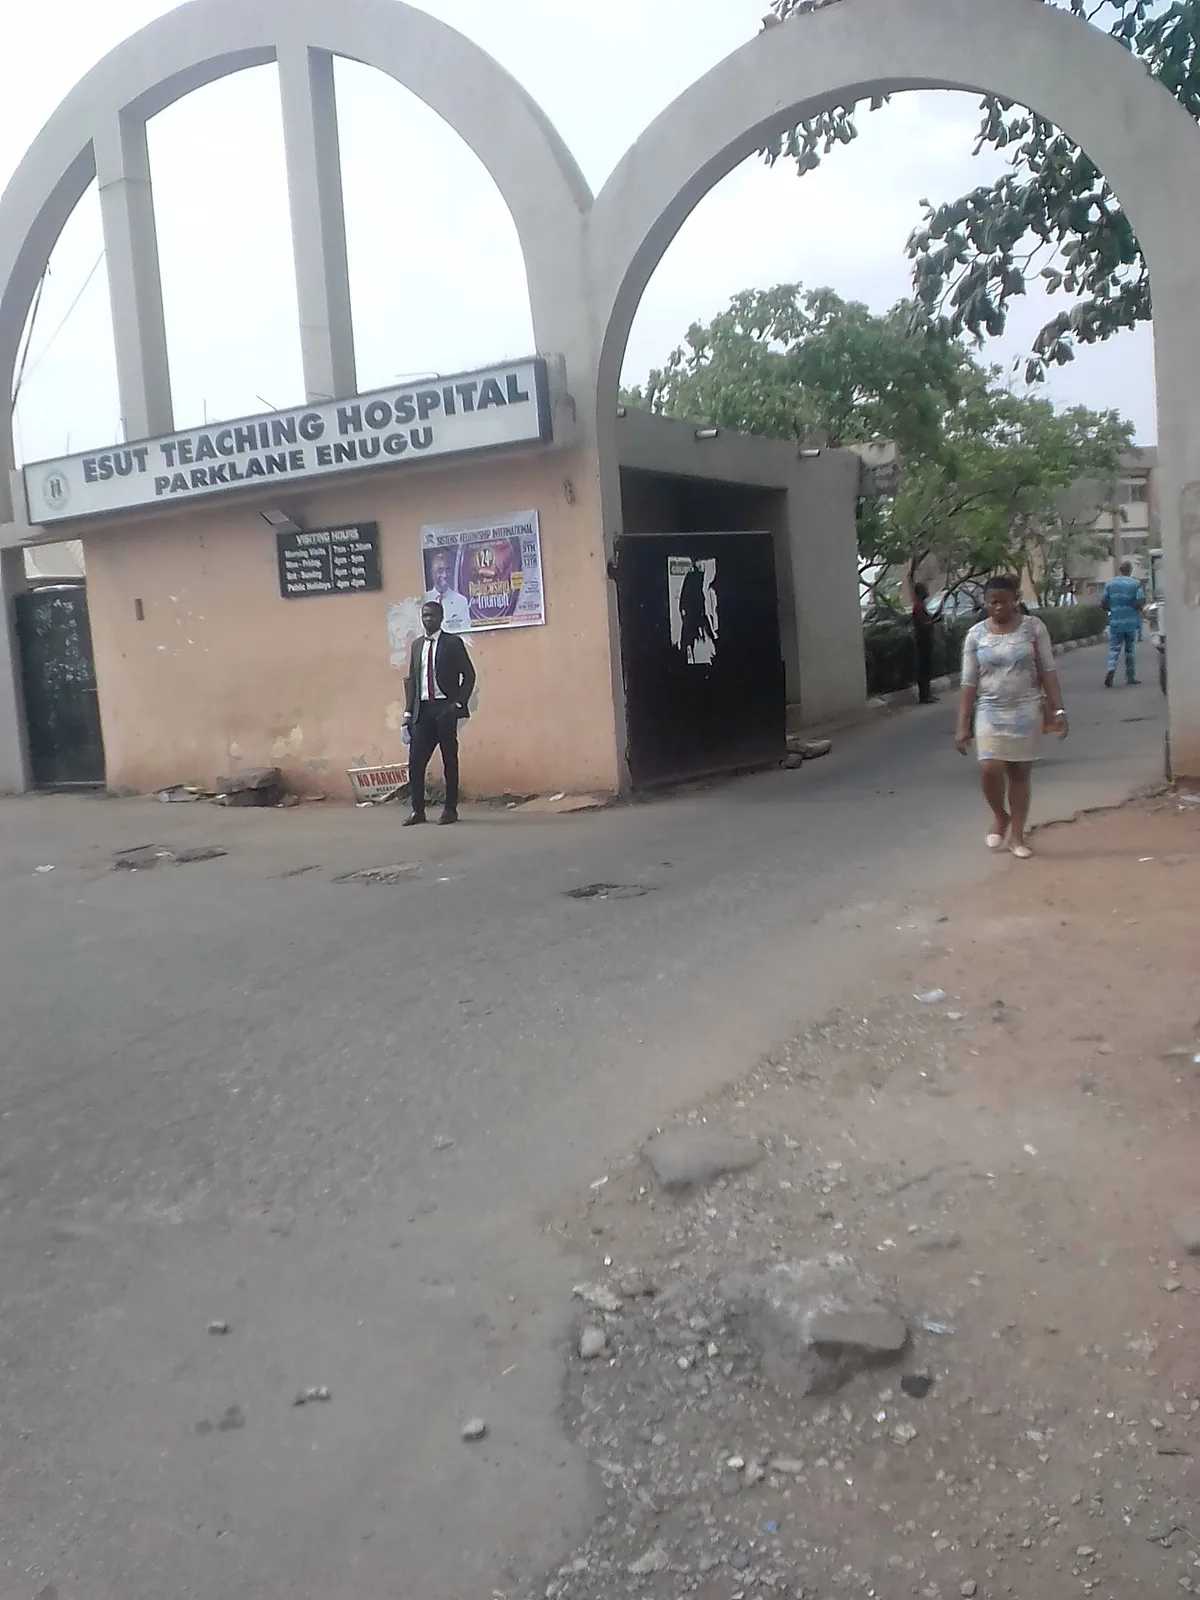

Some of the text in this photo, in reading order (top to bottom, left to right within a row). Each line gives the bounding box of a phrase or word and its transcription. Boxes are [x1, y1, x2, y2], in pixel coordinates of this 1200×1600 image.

[82, 373, 529, 483] ESUT TEACHING HOSPITAL
[154, 426, 434, 496] PARKLANE ENUGU
[296, 528, 359, 546] VISITING HOURS
[459, 529, 491, 543] FELLOWSHIP
[492, 523, 533, 538] INTERNATIONAL
[477, 592, 509, 609] Triumph
[356, 769, 408, 787] NO PARKING
